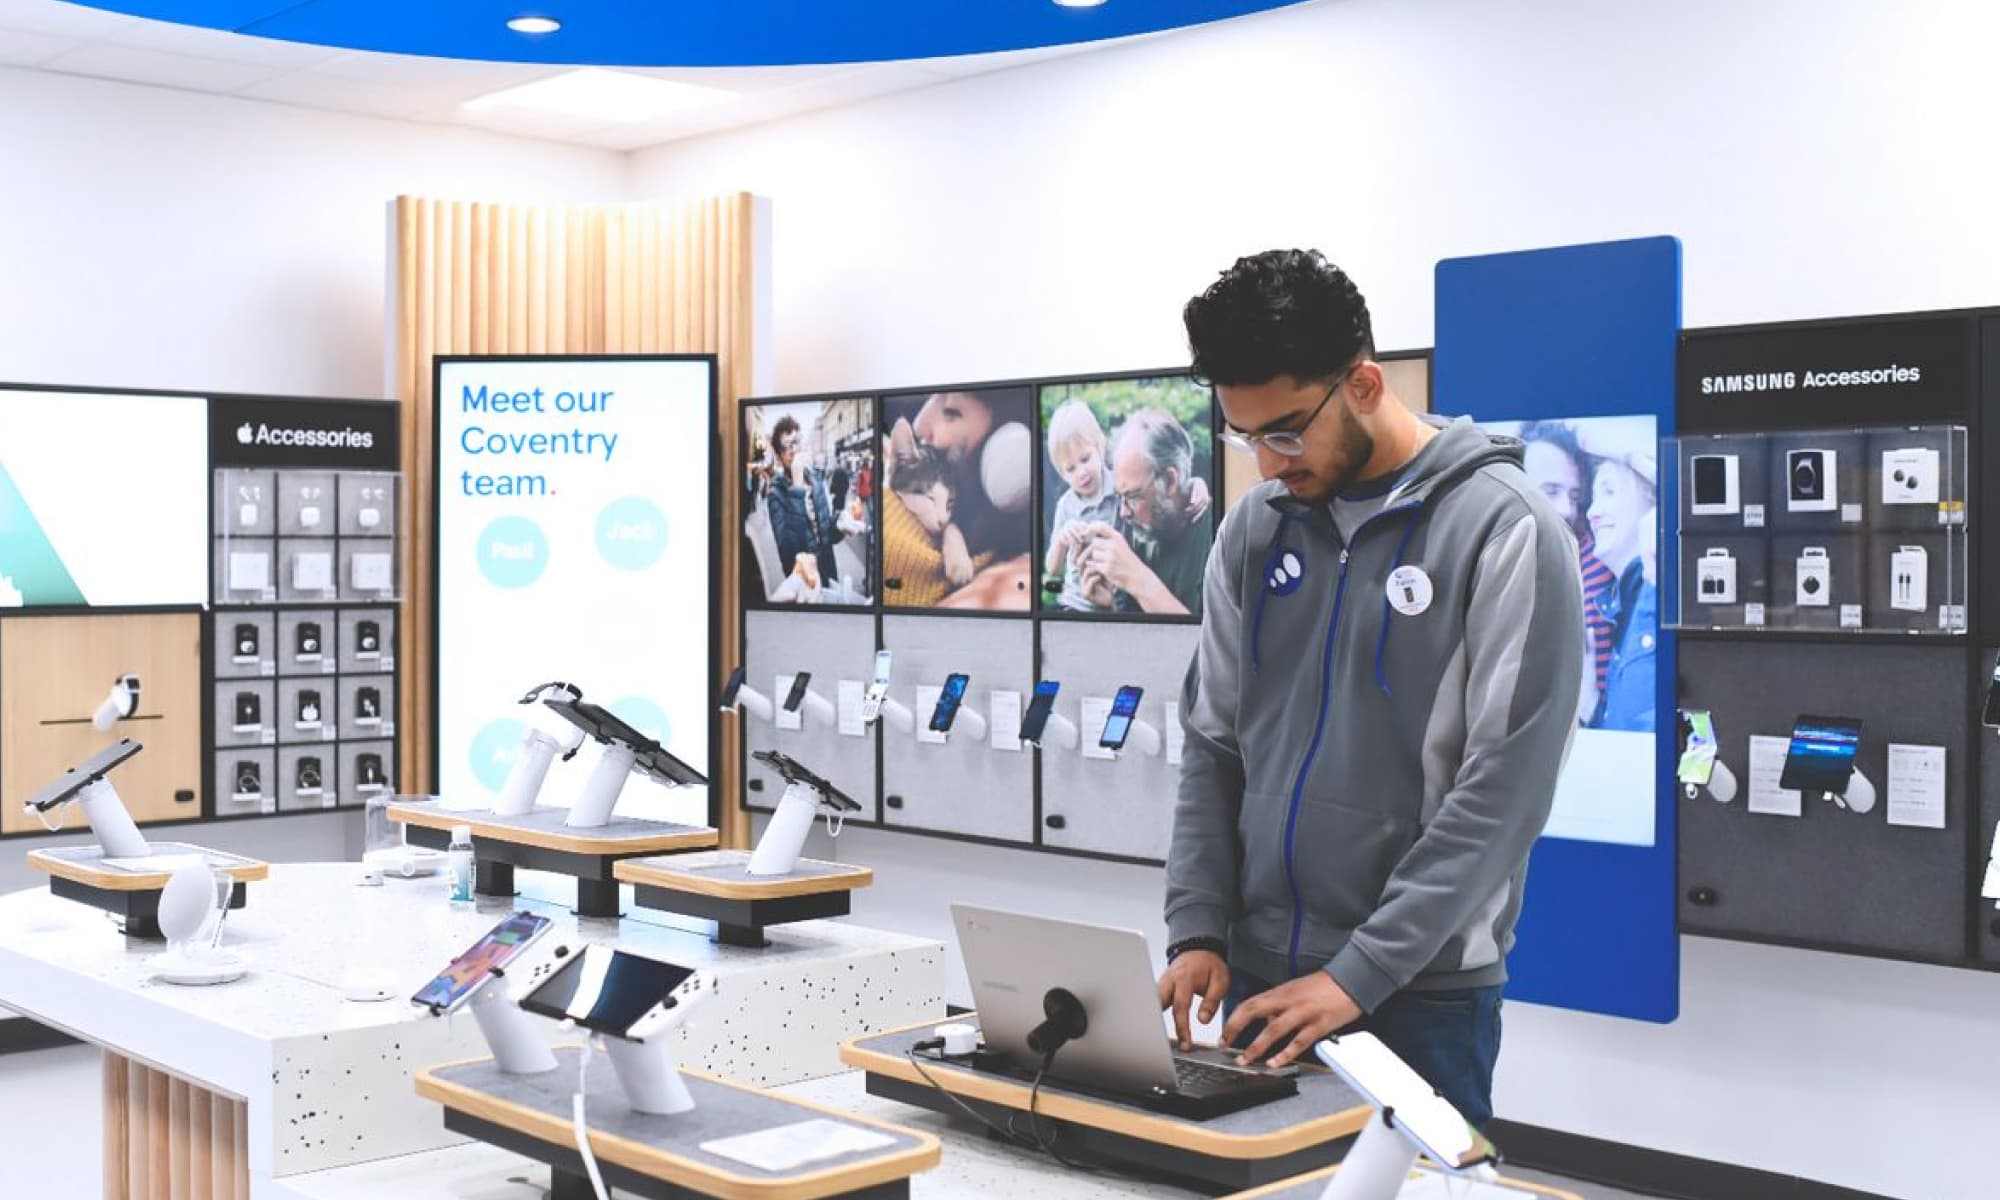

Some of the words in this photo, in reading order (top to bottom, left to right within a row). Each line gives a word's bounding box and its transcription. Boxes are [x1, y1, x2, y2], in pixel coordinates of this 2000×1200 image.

[1701, 371, 1796, 394] SAMSUNG
[1803, 364, 1920, 388] Accessories
[462, 385, 545, 413] Meet
[554, 391, 614, 413] our
[255, 423, 373, 448] Accessories
[460, 426, 618, 462] Coventry
[461, 470, 556, 496] team.
